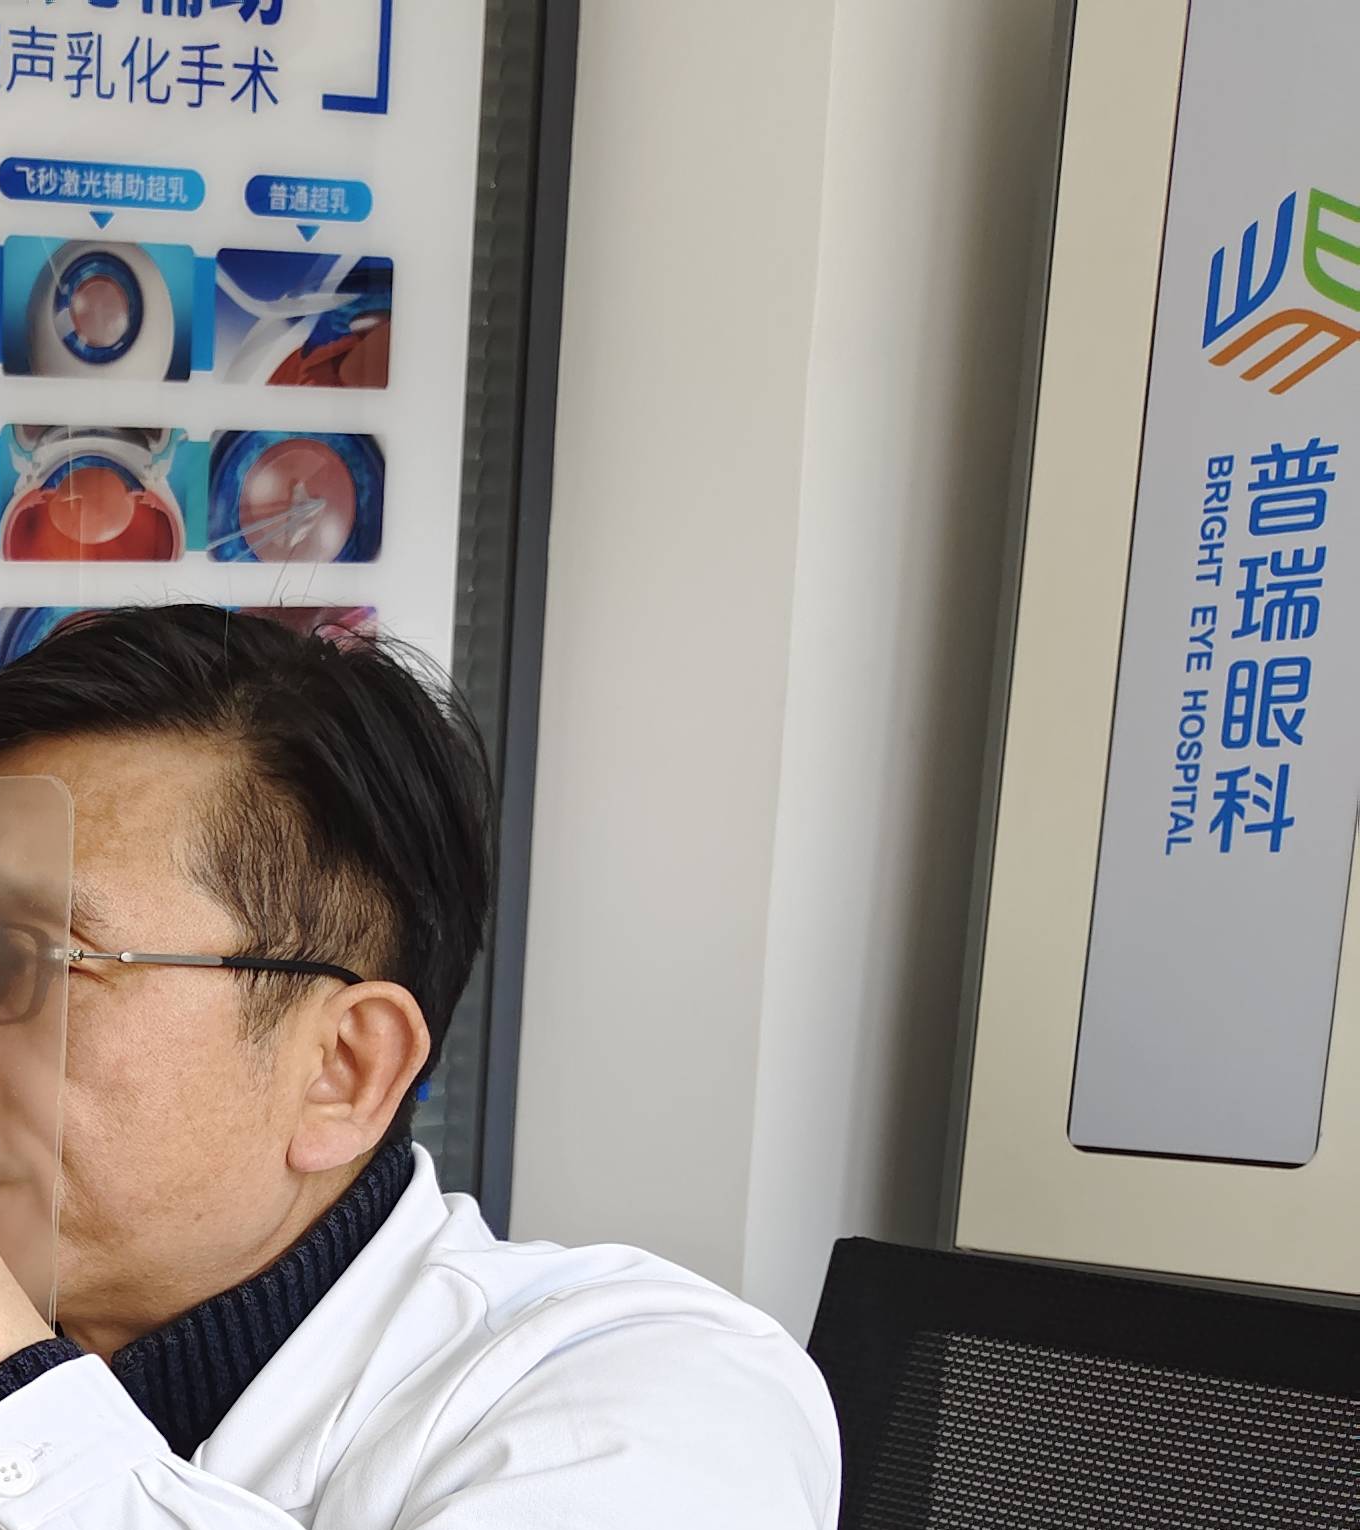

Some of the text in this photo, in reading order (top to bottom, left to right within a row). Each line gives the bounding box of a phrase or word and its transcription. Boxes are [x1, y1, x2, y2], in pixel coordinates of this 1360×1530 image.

[15, 164, 189, 204] 飞秒激光辅助超乳
[268, 183, 350, 215] 普通超乳
[1164, 453, 1235, 856] BRIGHT EYE HOSPITAL
[1209, 436, 1341, 855] 普瑞眼科
